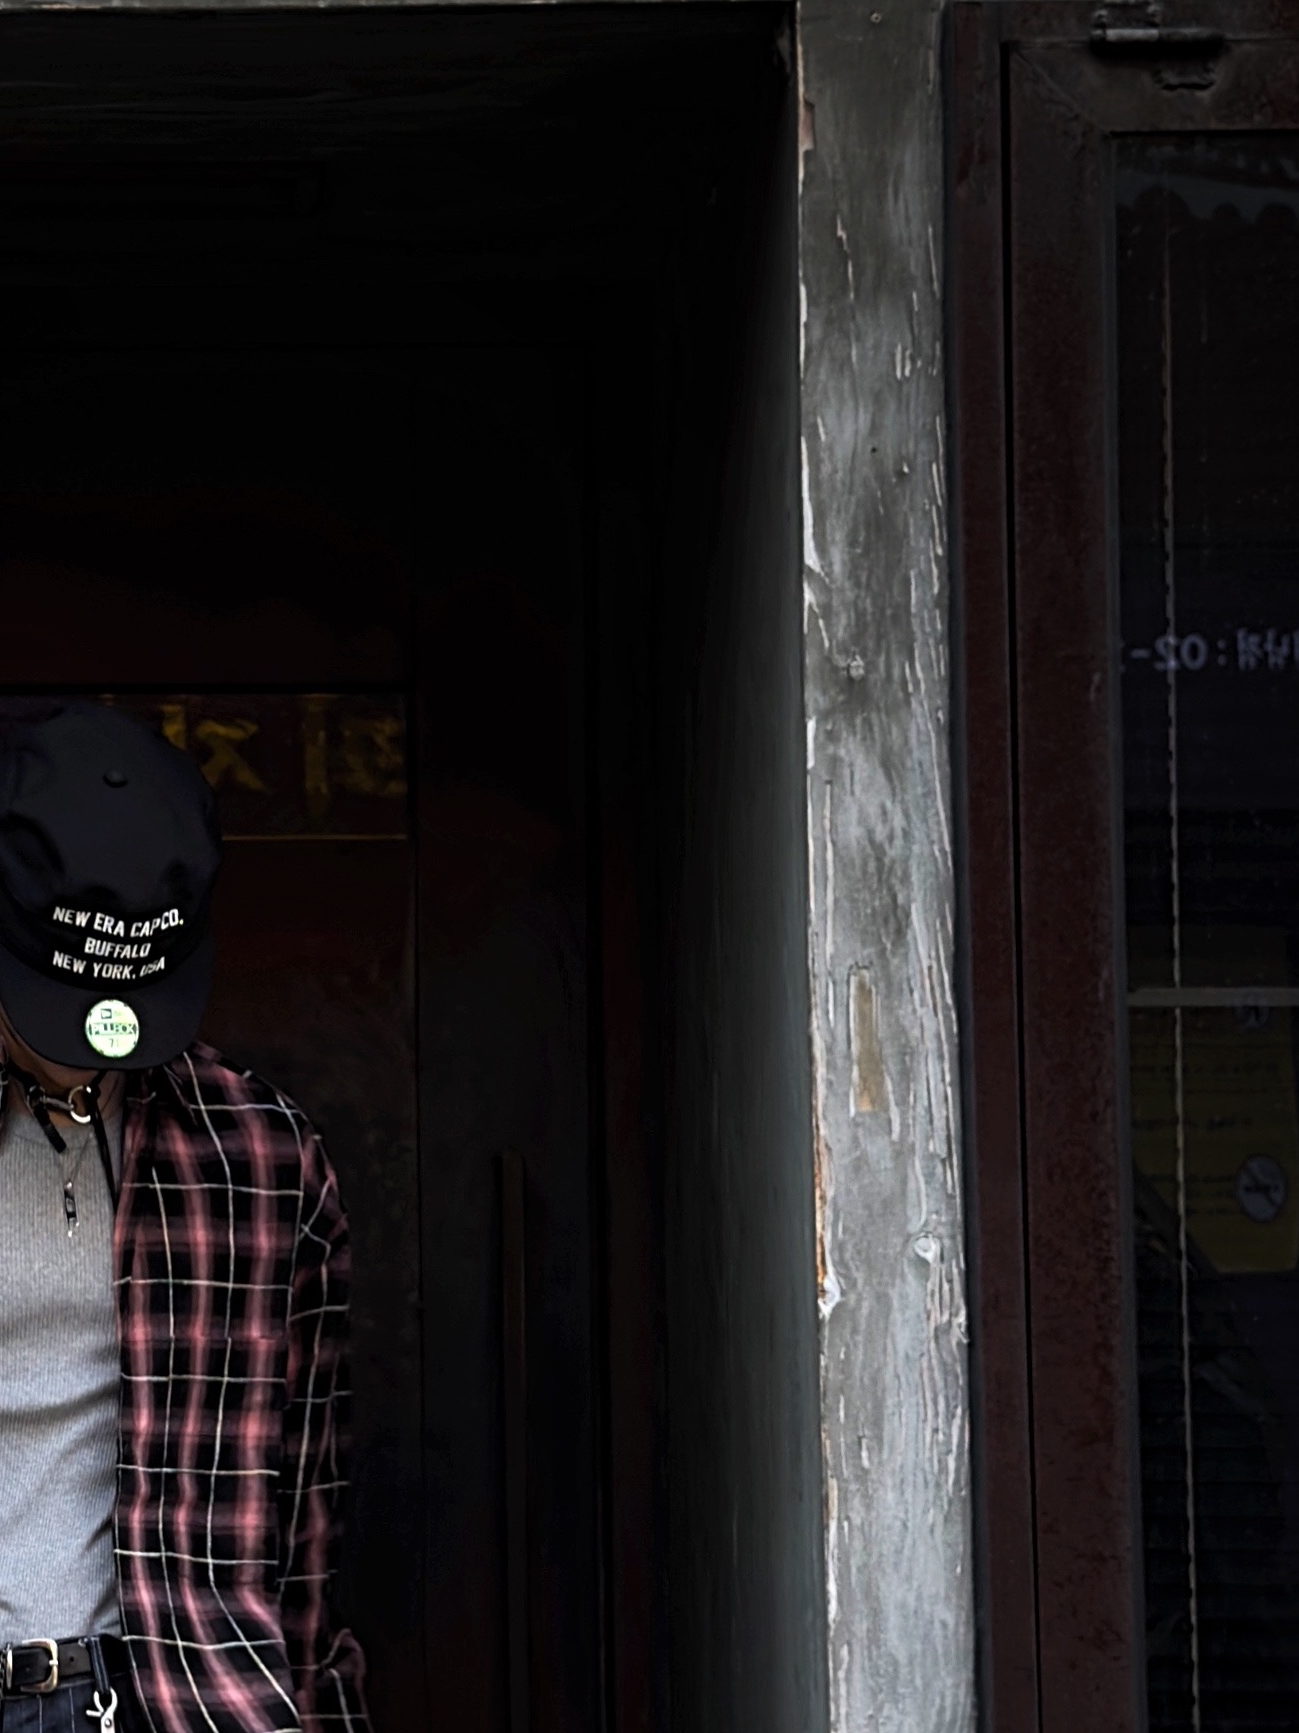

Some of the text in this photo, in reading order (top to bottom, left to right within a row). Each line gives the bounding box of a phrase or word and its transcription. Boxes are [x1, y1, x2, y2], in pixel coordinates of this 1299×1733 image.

[52, 905, 91, 928] NEW
[93, 912, 126, 938] ERA
[84, 936, 152, 959] BUFFALO
[52, 949, 87, 975] NEW
[139, 956, 166, 977] USA
